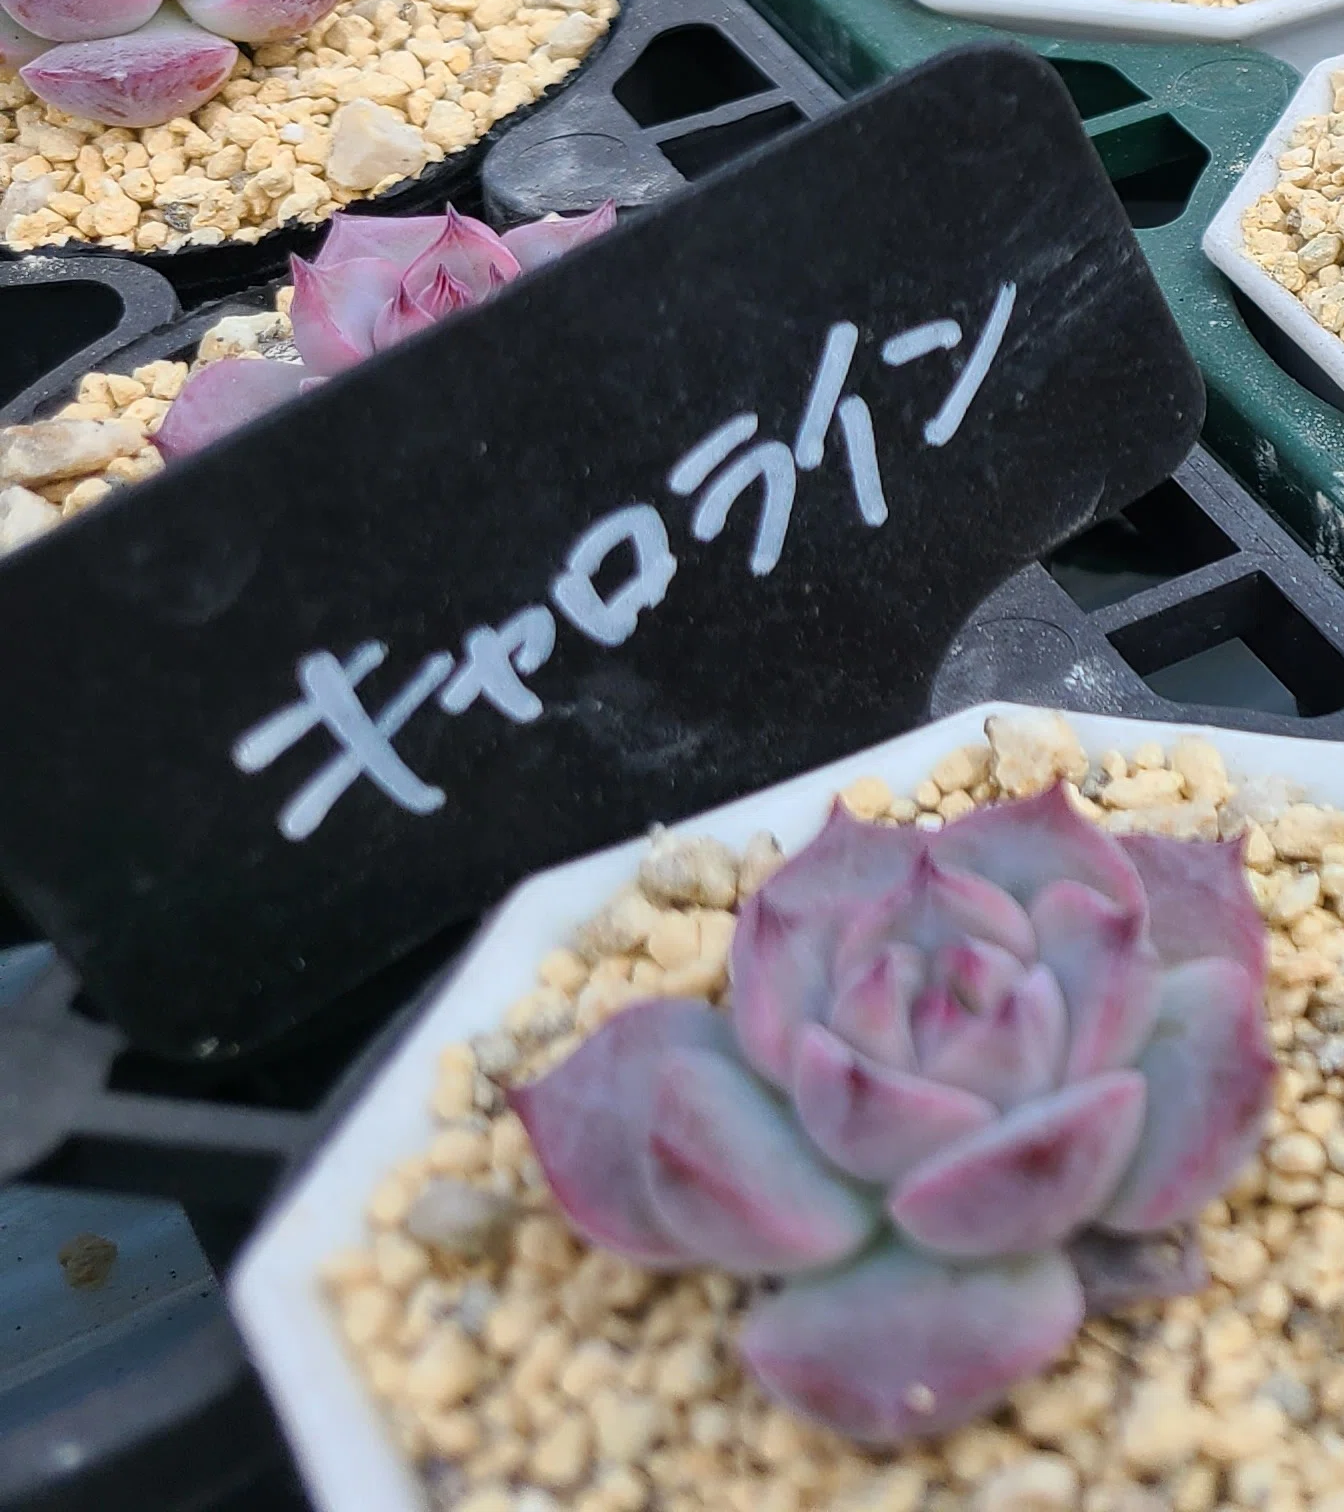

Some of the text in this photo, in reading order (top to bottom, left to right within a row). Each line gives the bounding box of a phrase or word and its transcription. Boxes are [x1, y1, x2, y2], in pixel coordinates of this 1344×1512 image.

[232, 282, 1016, 840] キャロライン
